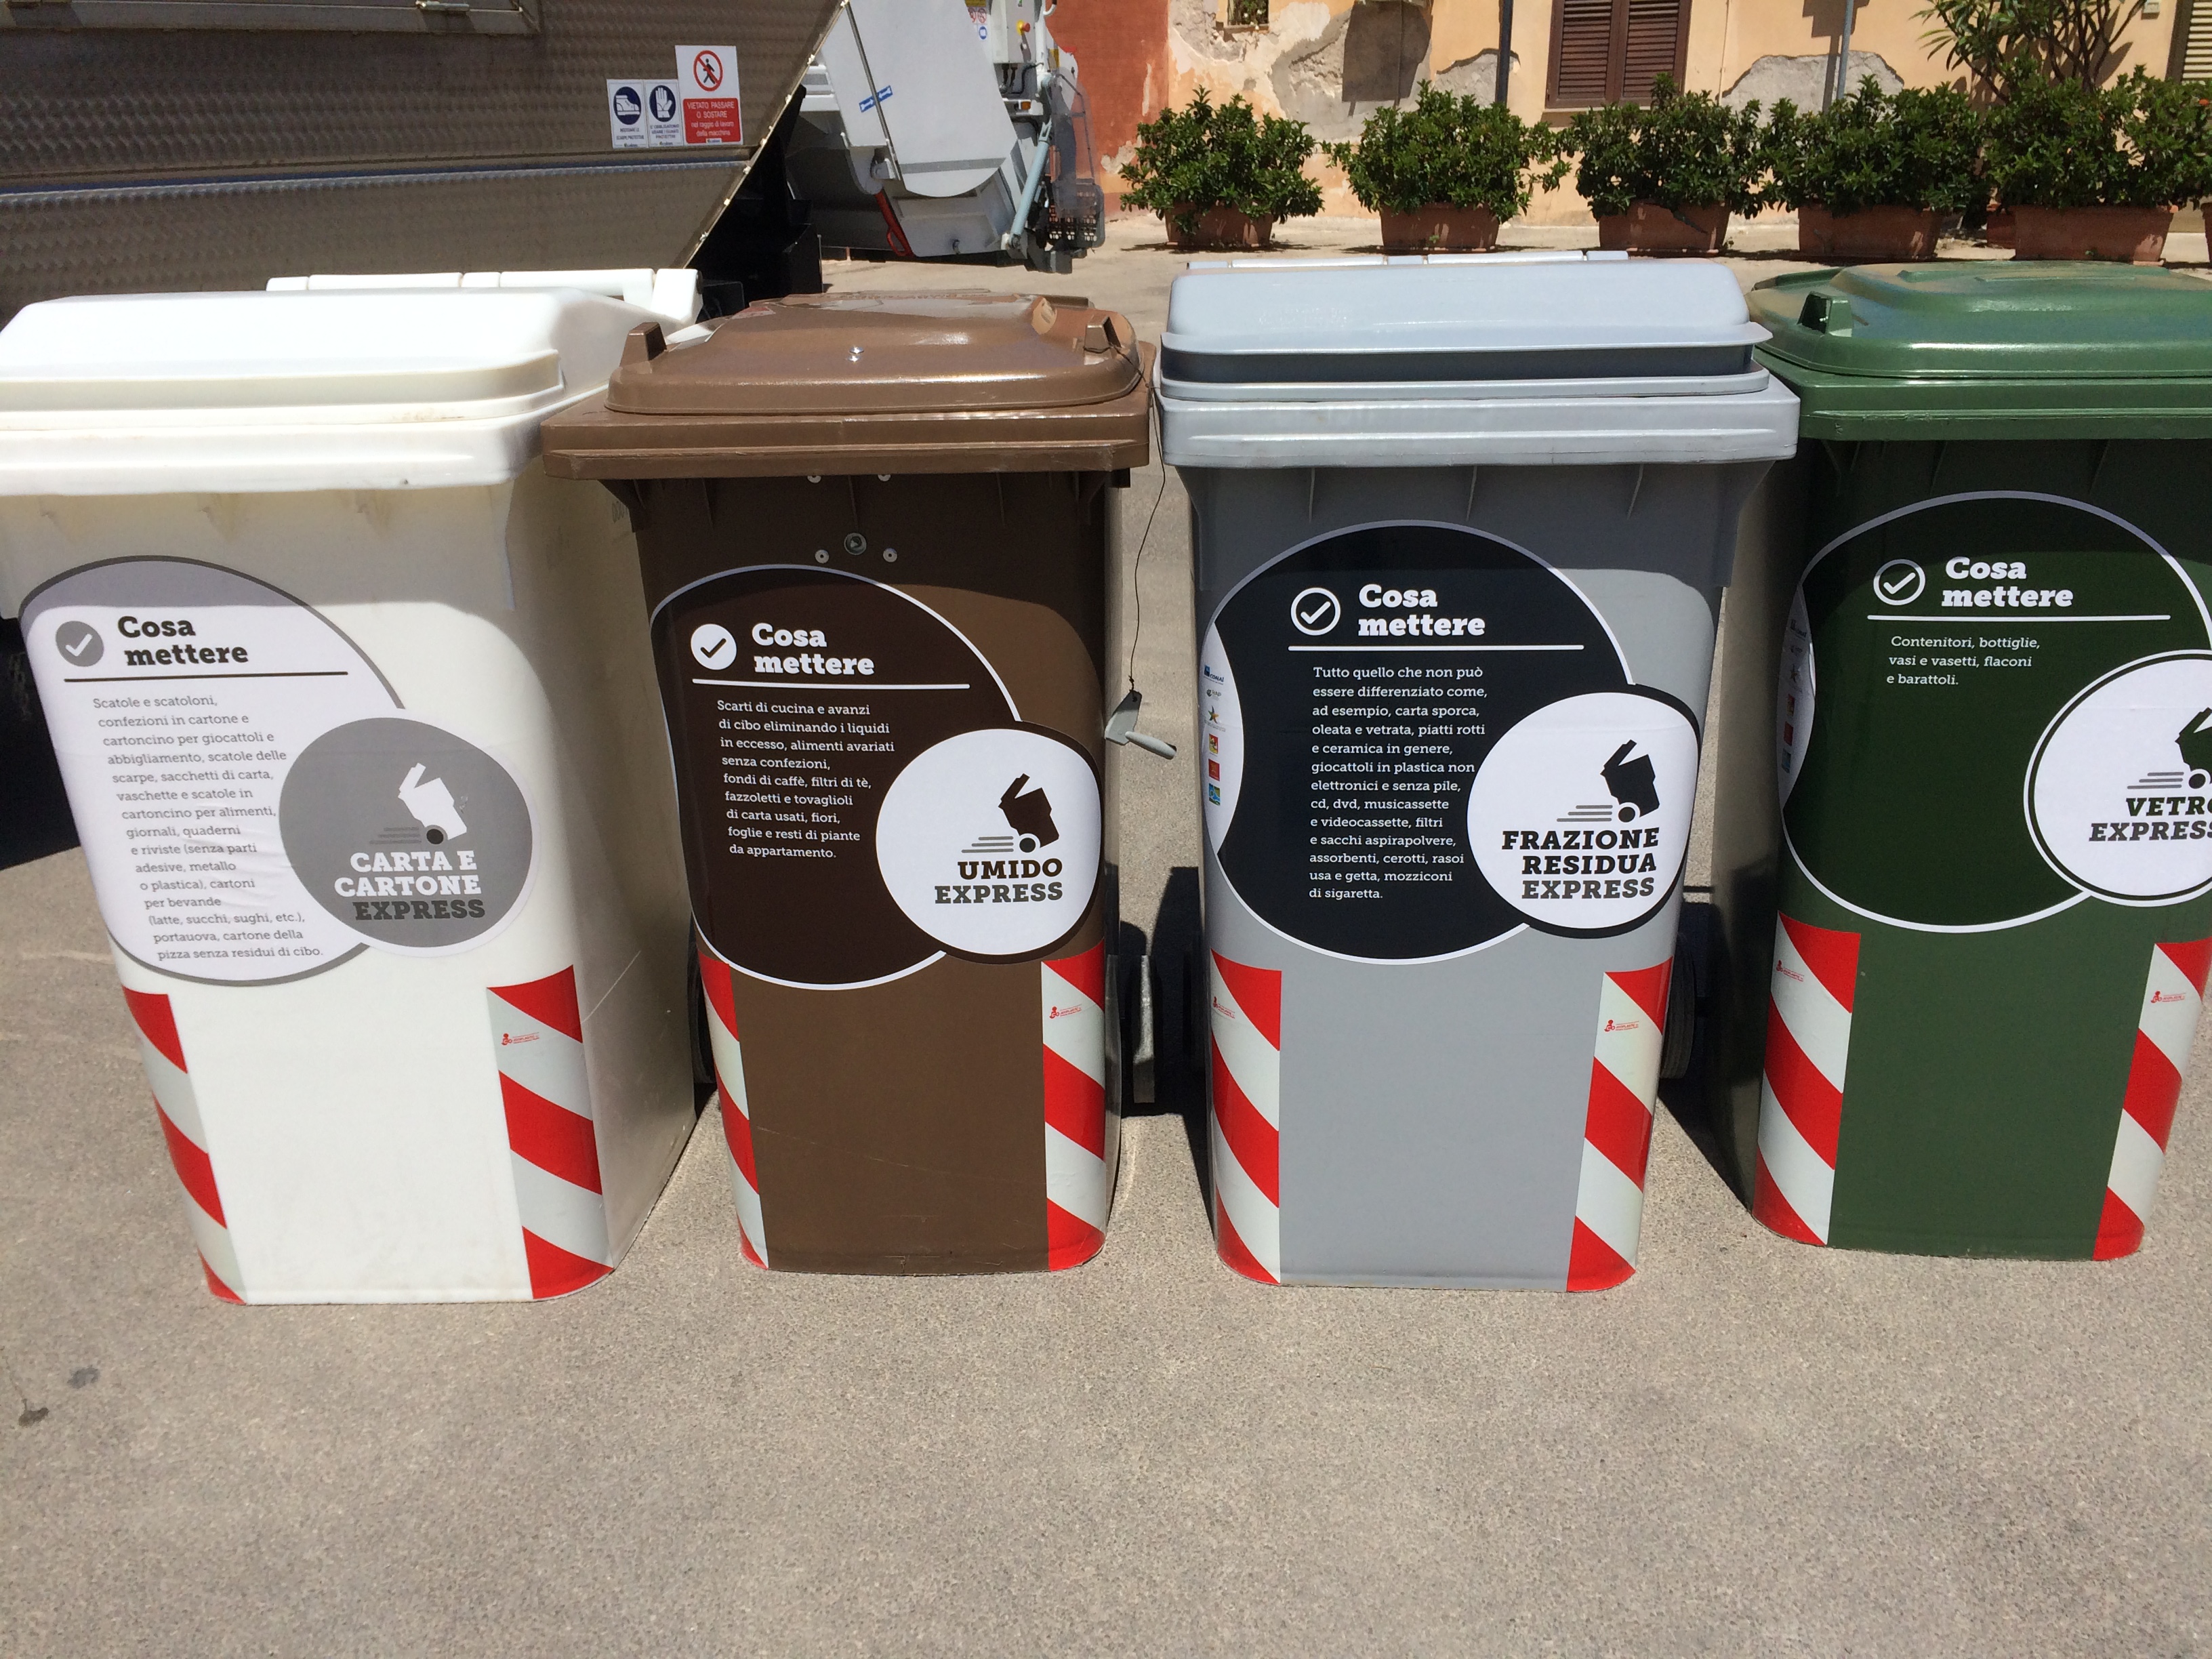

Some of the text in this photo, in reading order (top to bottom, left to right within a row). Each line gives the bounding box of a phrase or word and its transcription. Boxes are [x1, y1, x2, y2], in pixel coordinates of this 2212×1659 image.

[696, 110, 728, 119] O SOSTARE
[1945, 556, 2026, 579] Cosa
[1359, 583, 1437, 607] Cosa
[1941, 586, 2073, 607] mettere
[117, 615, 196, 638] Cosa
[1358, 614, 1485, 636] mettere
[752, 622, 827, 647] Cosa
[1891, 636, 2039, 650] Contenitori, bottiglie,
[124, 644, 248, 665] mettere
[1889, 655, 2032, 668] vasi vasetti, flaconi
[754, 653, 874, 675] mettere
[1313, 666, 1483, 680] Tutto quello che non può
[1898, 673, 1958, 684] barattoli.
[1313, 686, 1487, 697] essere differenziato come,
[93, 695, 217, 708] Scatole scatoloni,
[717, 699, 870, 714] Scarti di cucina avanzi
[1312, 705, 1479, 718] ad esempio, carta sporca,
[98, 715, 238, 727] confezioni in cartone
[718, 718, 889, 735] di cibo eliminando liquidi
[1312, 724, 1485, 737] oleata vetrata, piatti rotti
[103, 731, 264, 746] cartoncino per giocattoli
[720, 737, 895, 751] in eccesso, alimenti avariati
[1322, 743, 1452, 756] ceramica in genere,
[108, 750, 286, 766] abbigliamento, scatole delle
[722, 757, 830, 770] senza confezioni,
[1311, 762, 1475, 774] giocattoli in plastica non
[112, 770, 273, 784] scarpe, sacchetti di carta,
[723, 773, 871, 789] fondi di caffè, filtri di tè,
[1311, 780, 1378, 790] elettronici
[1433, 780, 1460, 793] pile,
[116, 790, 178, 801] vaschette
[191, 788, 236, 799] scatole
[724, 791, 853, 806] fazzoletti tovaglioli
[1311, 798, 1449, 810] cd, dvd, musicassette
[2125, 796, 2212, 816] VETR
[121, 806, 277, 820] cartoncino per alimenti,
[726, 808, 840, 824] di carta usati, fiori,
[1320, 817, 1443, 828] videocassette, filtri
[126, 825, 241, 840] giornali, quaderni
[728, 826, 860, 842] foglie resti di piante
[2089, 820, 2212, 841] EXPRES
[1320, 835, 1456, 847] sacchi aspirapolvere,
[1502, 827, 1659, 850] FRAZIONE
[141, 844, 257, 855] riviste (senza parti
[729, 844, 836, 857] da appartamento.
[350, 850, 476, 872] CARTA E
[1309, 853, 1464, 864] assorbenti, cerotti, rasoi
[1521, 853, 1656, 874] RESIDUA
[136, 861, 236, 872] adesive, metallo
[957, 858, 1062, 880] UMIDO
[1345, 872, 1380, 882] getta,
[1384, 871, 1452, 881] mozziconi
[150, 880, 255, 892] plastica), cartoni
[334, 874, 481, 897] CARTONE
[934, 881, 1063, 903] EXPRESS
[1521, 877, 1654, 899] EXPRESS
[1309, 888, 1382, 900] di sigaretta.
[144, 897, 221, 909] per bevande
[352, 899, 485, 920] EXPRESS
[148, 912, 304, 925] (latte, succhi, sughi, etc.),
[152, 929, 303, 944] portauova, cartone della
[157, 946, 323, 961] pizza senza residui di cibo.
